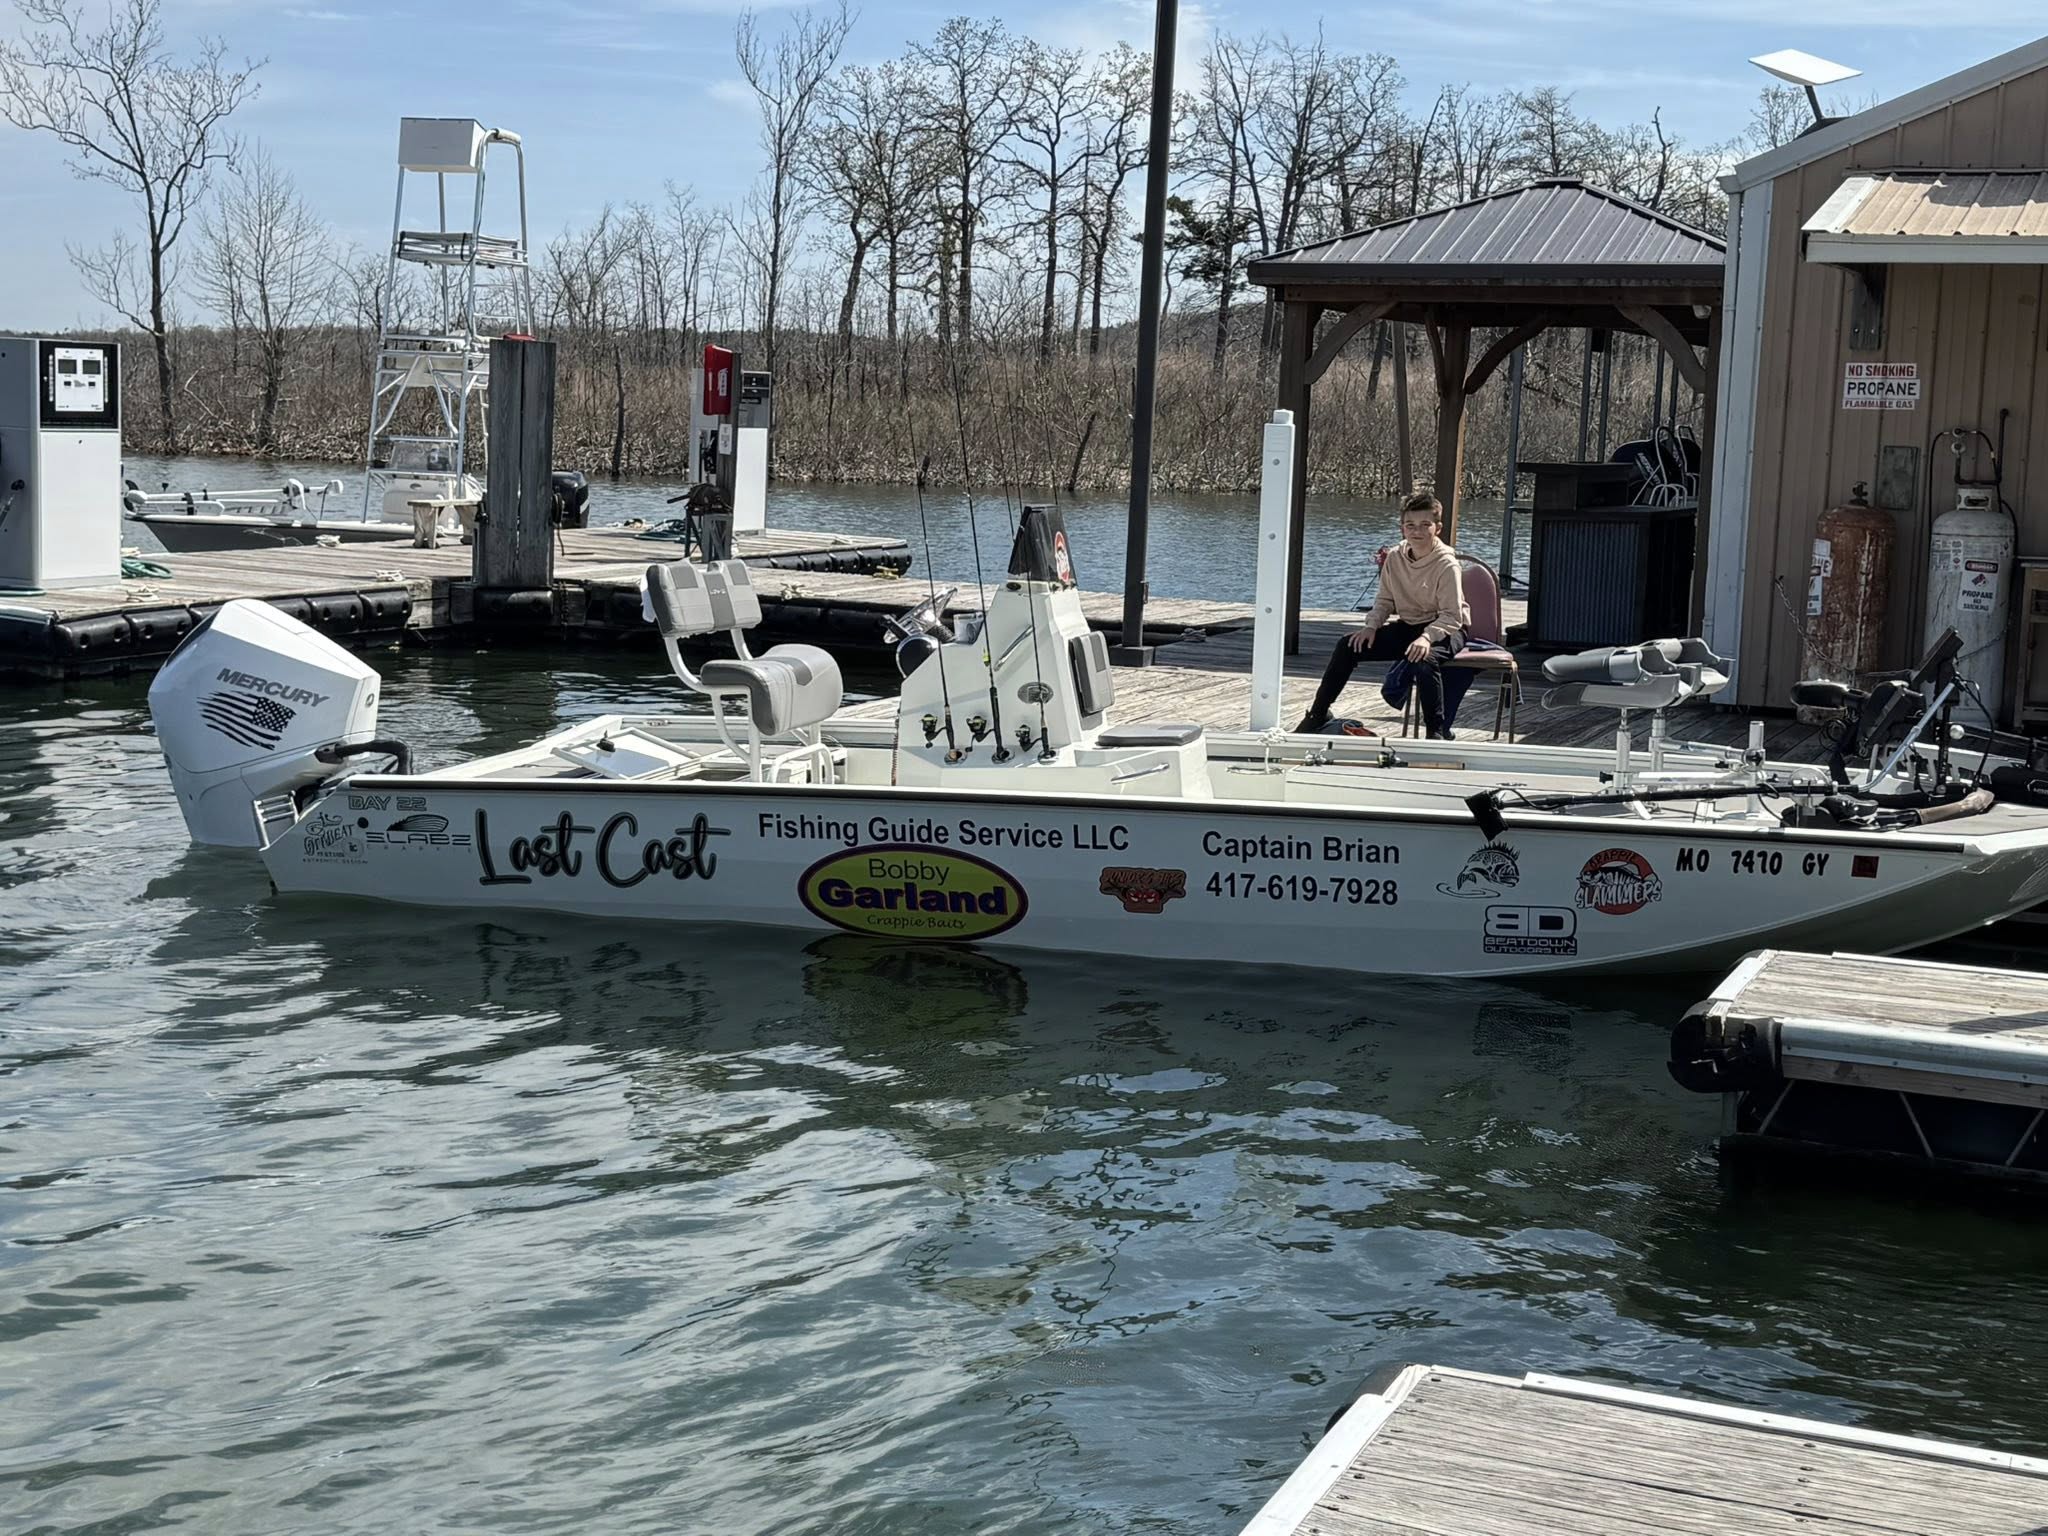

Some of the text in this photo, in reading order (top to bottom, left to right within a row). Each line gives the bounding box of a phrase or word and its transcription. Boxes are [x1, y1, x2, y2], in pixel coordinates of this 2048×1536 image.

[1848, 364, 1914, 377] NO SMOKING
[1847, 381, 1917, 396] PROPANE
[1845, 400, 1913, 409] FLAMMABLE GAS
[1962, 590, 1993, 600] PROPANE
[216, 667, 331, 707] MERCURY
[348, 795, 427, 811] BAY 22
[758, 812, 1130, 851] Fishing Guide Service LLC
[475, 808, 731, 888] Last Cast
[1202, 830, 1400, 864] Captain Brian
[868, 858, 949, 885] Bobby
[1675, 848, 1710, 872] MO
[1802, 852, 1830, 876] GY
[818, 878, 1009, 916] Garland
[1206, 871, 1399, 905] 417-619-7928
[1575, 880, 1663, 909] SLAMMERS
[867, 914, 967, 930] Crappie Baits
[1484, 945, 1577, 955] OUTDOORS LLC
[1485, 936, 1576, 947] BEATDOWN
